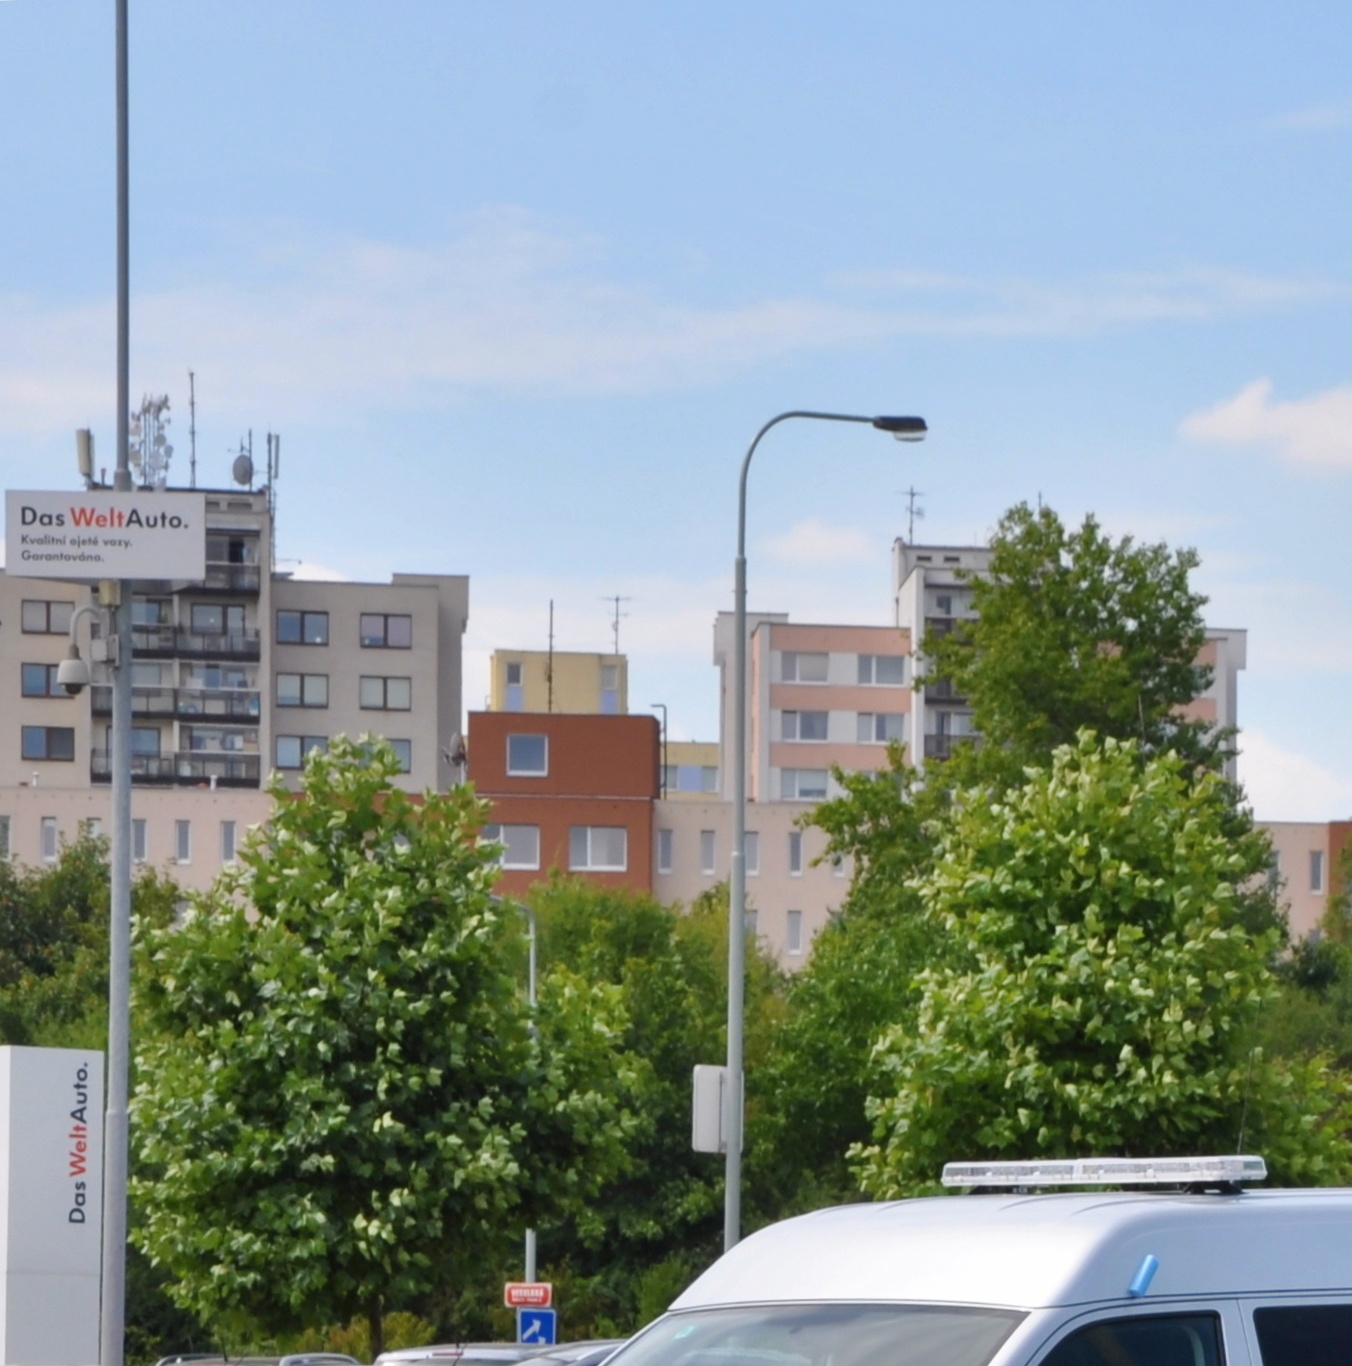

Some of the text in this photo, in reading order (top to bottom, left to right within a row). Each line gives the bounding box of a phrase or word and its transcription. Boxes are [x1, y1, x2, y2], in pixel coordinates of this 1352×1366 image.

[20, 506, 189, 529] Das WeltAuto.
[21, 534, 66, 546] Kvalitní
[69, 536, 99, 548] ojeté
[21, 550, 105, 562] Garantováno.
[68, 1062, 88, 1224] Das WeltAuto.
